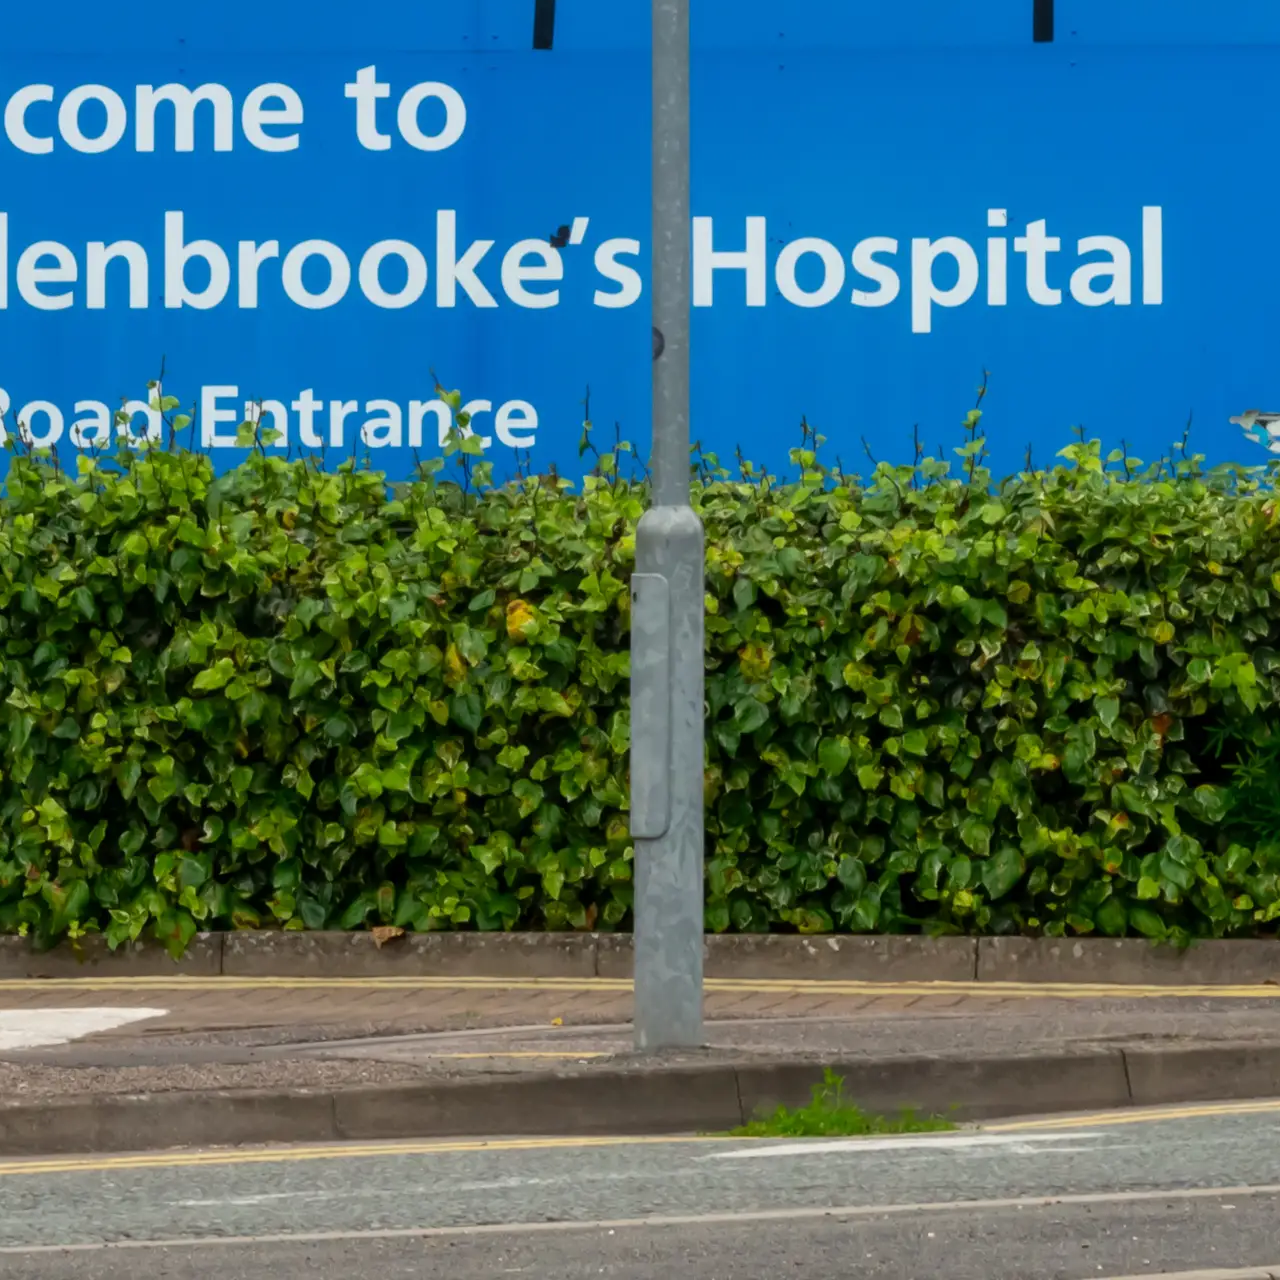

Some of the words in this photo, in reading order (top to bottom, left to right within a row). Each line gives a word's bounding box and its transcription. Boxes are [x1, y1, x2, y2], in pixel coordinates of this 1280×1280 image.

[344, 65, 467, 152] to
[692, 205, 1163, 334] Hospital
[200, 385, 539, 449] Entrance
